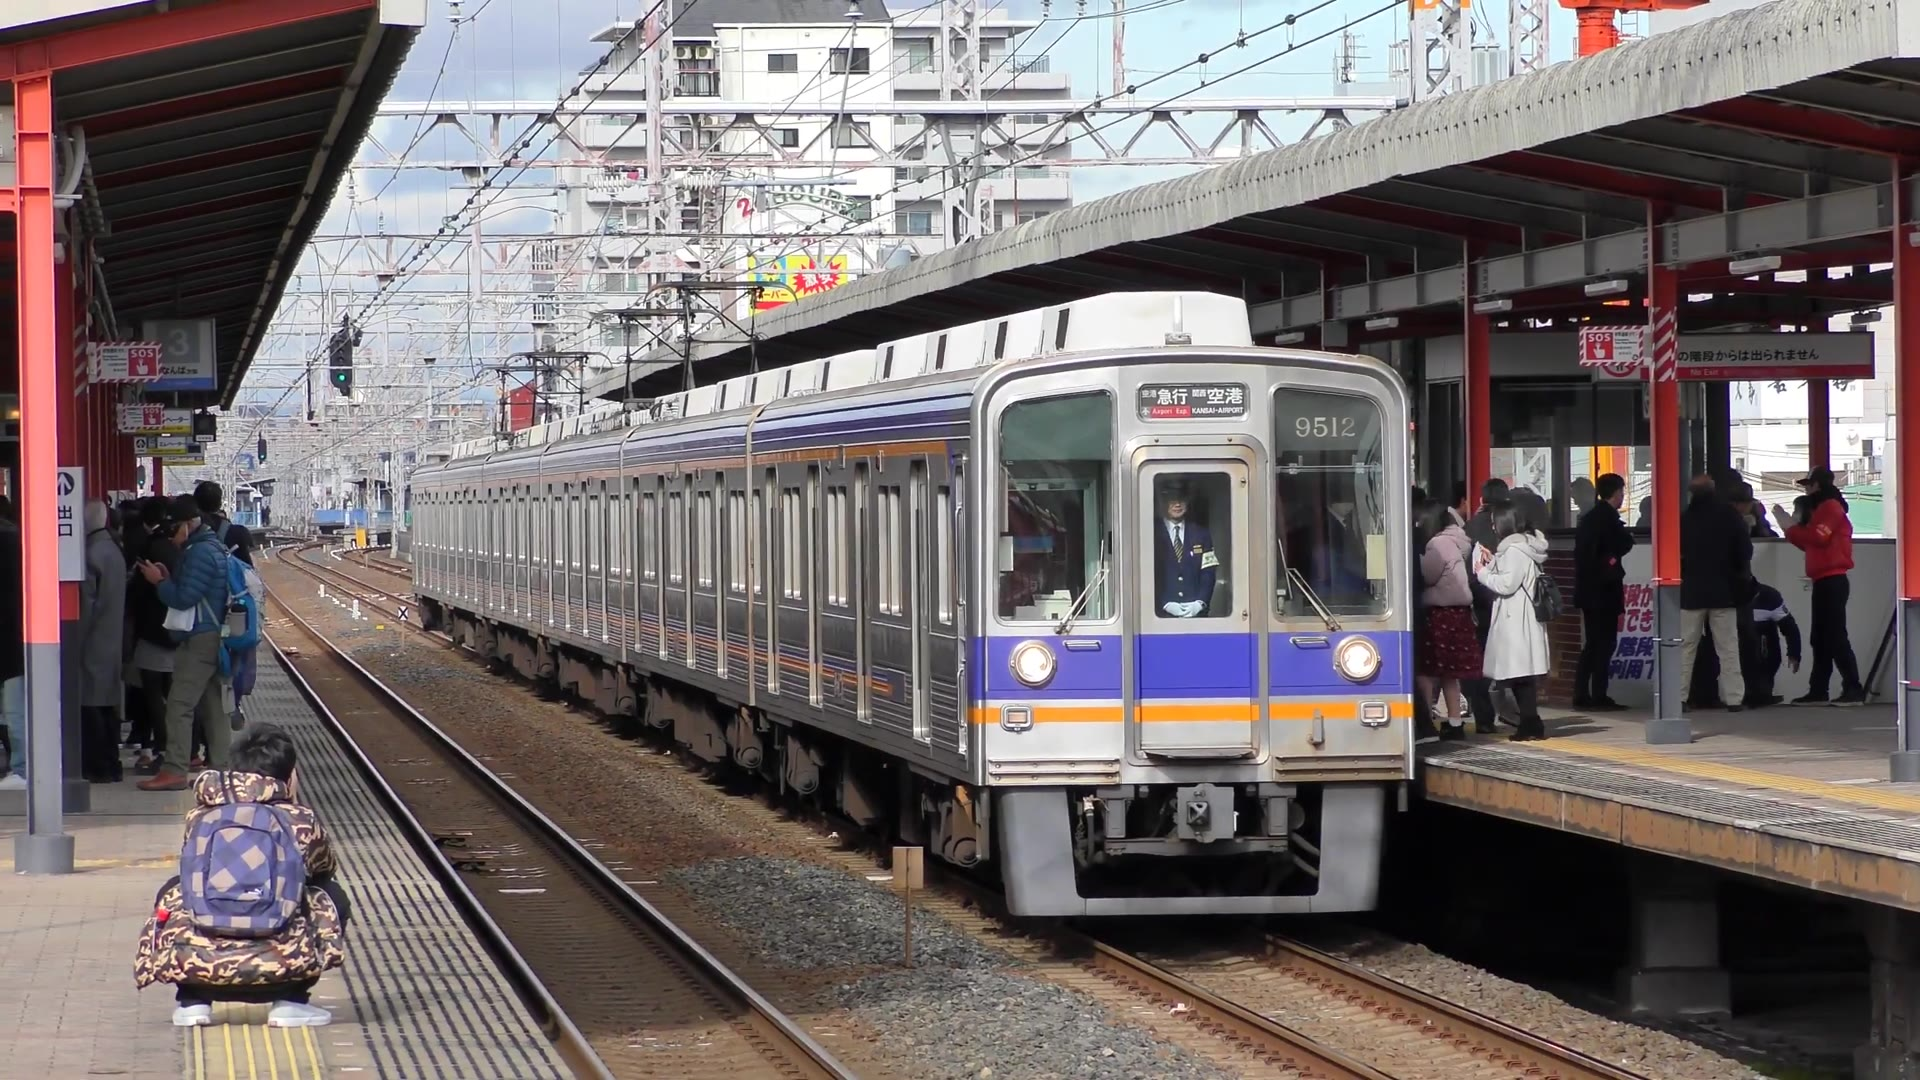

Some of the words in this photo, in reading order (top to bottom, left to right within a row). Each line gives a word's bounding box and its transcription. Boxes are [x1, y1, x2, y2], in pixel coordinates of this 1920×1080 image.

[168, 328, 190, 356] 3
[1588, 333, 1611, 342] SOS
[131, 349, 154, 358] SOS
[1295, 417, 1356, 437] 9512
[58, 505, 72, 536] 出口
